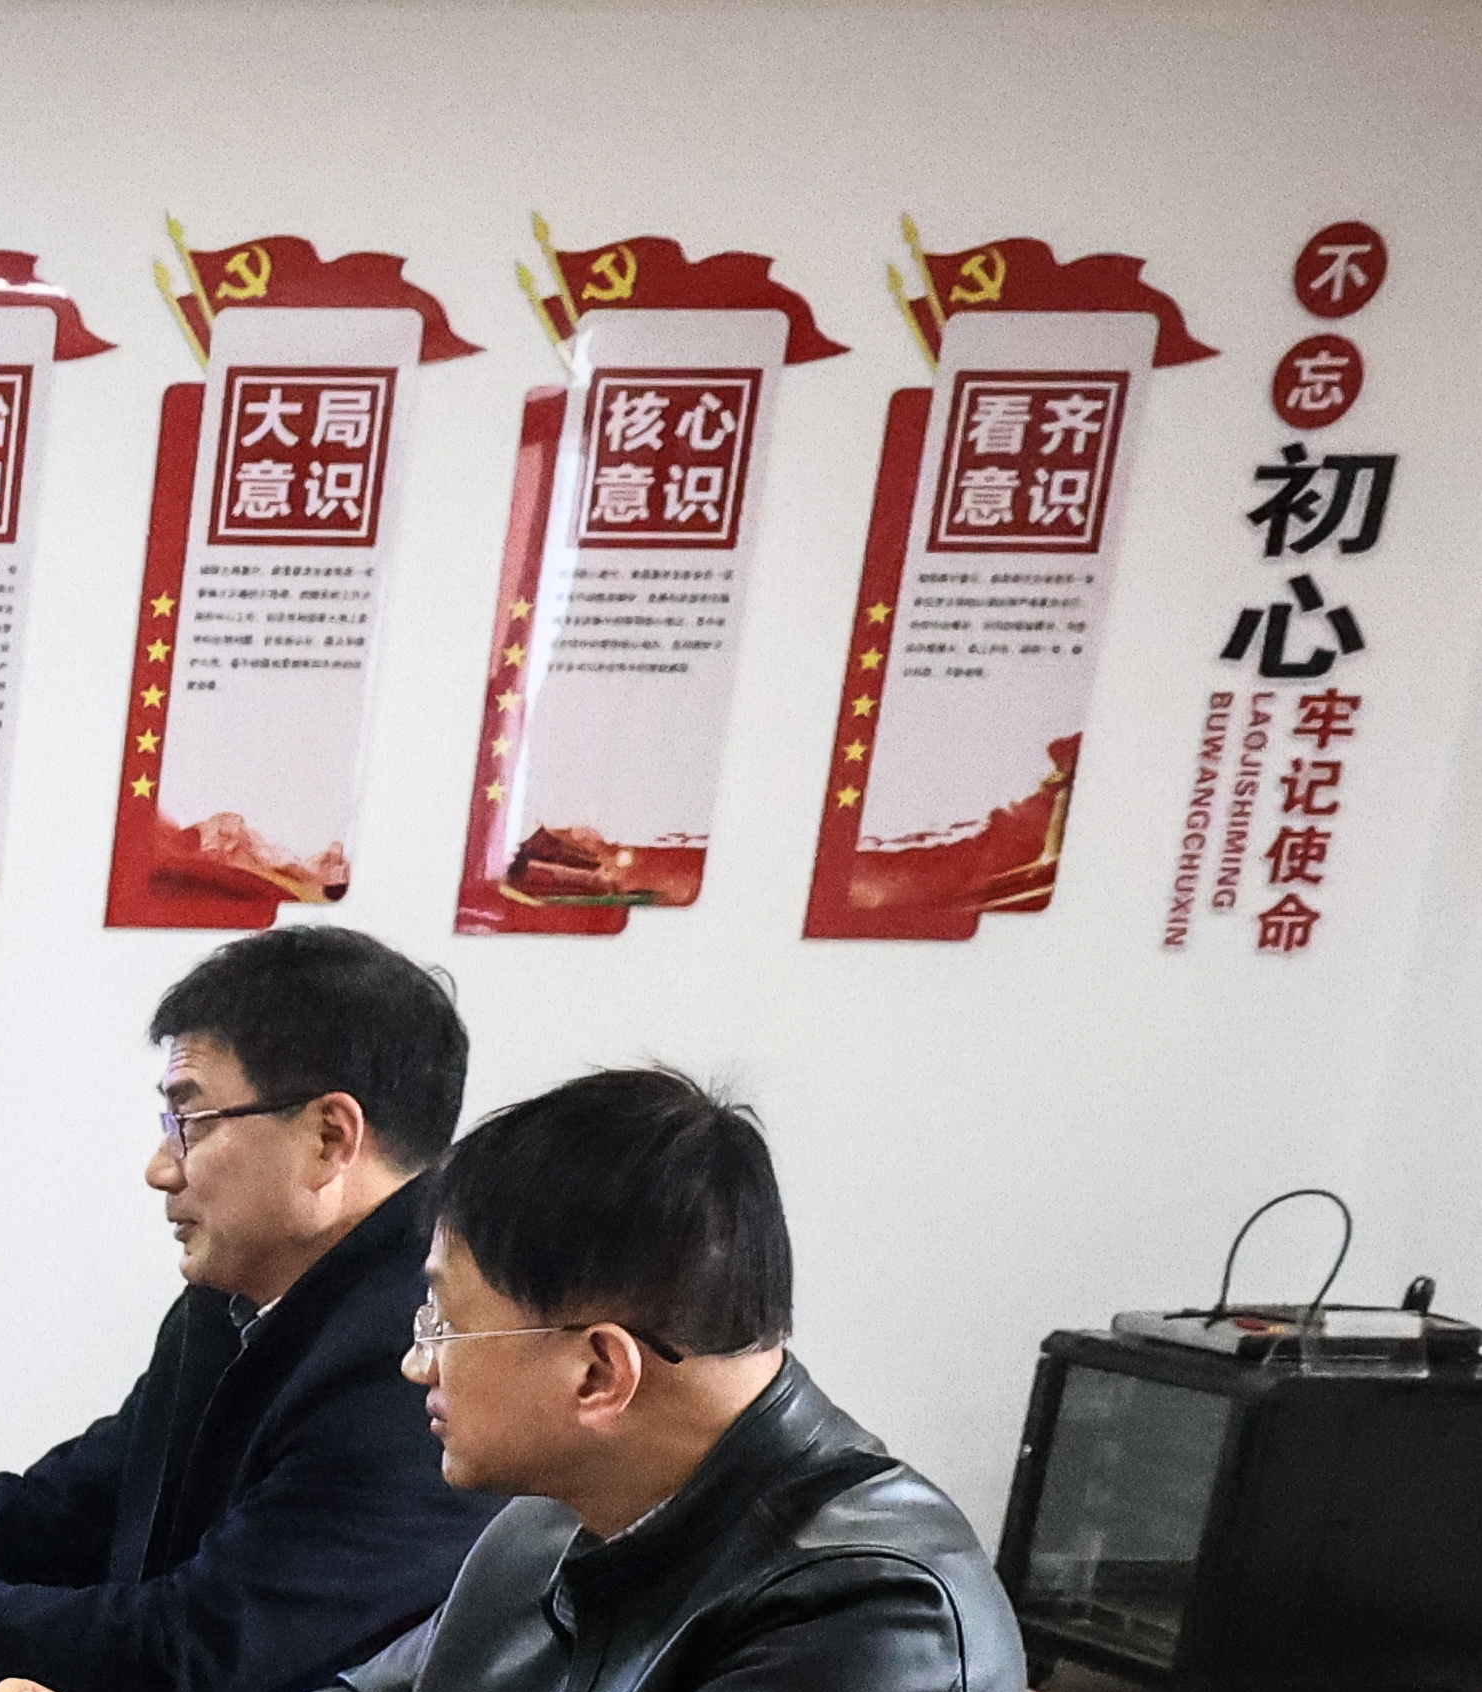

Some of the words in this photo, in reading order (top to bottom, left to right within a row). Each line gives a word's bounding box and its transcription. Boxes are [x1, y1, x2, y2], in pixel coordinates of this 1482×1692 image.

[240, 387, 372, 449] 大局
[602, 388, 737, 453] 核心
[967, 394, 1102, 456] 看齐
[231, 460, 363, 522] 意识
[590, 462, 725, 524] 意识
[954, 465, 1089, 527] 意识
[1164, 690, 1235, 947] BUWANGCHUXIN
[1211, 691, 1275, 909] LAOJISHIMING
[1257, 687, 1363, 952] 牢记使命
